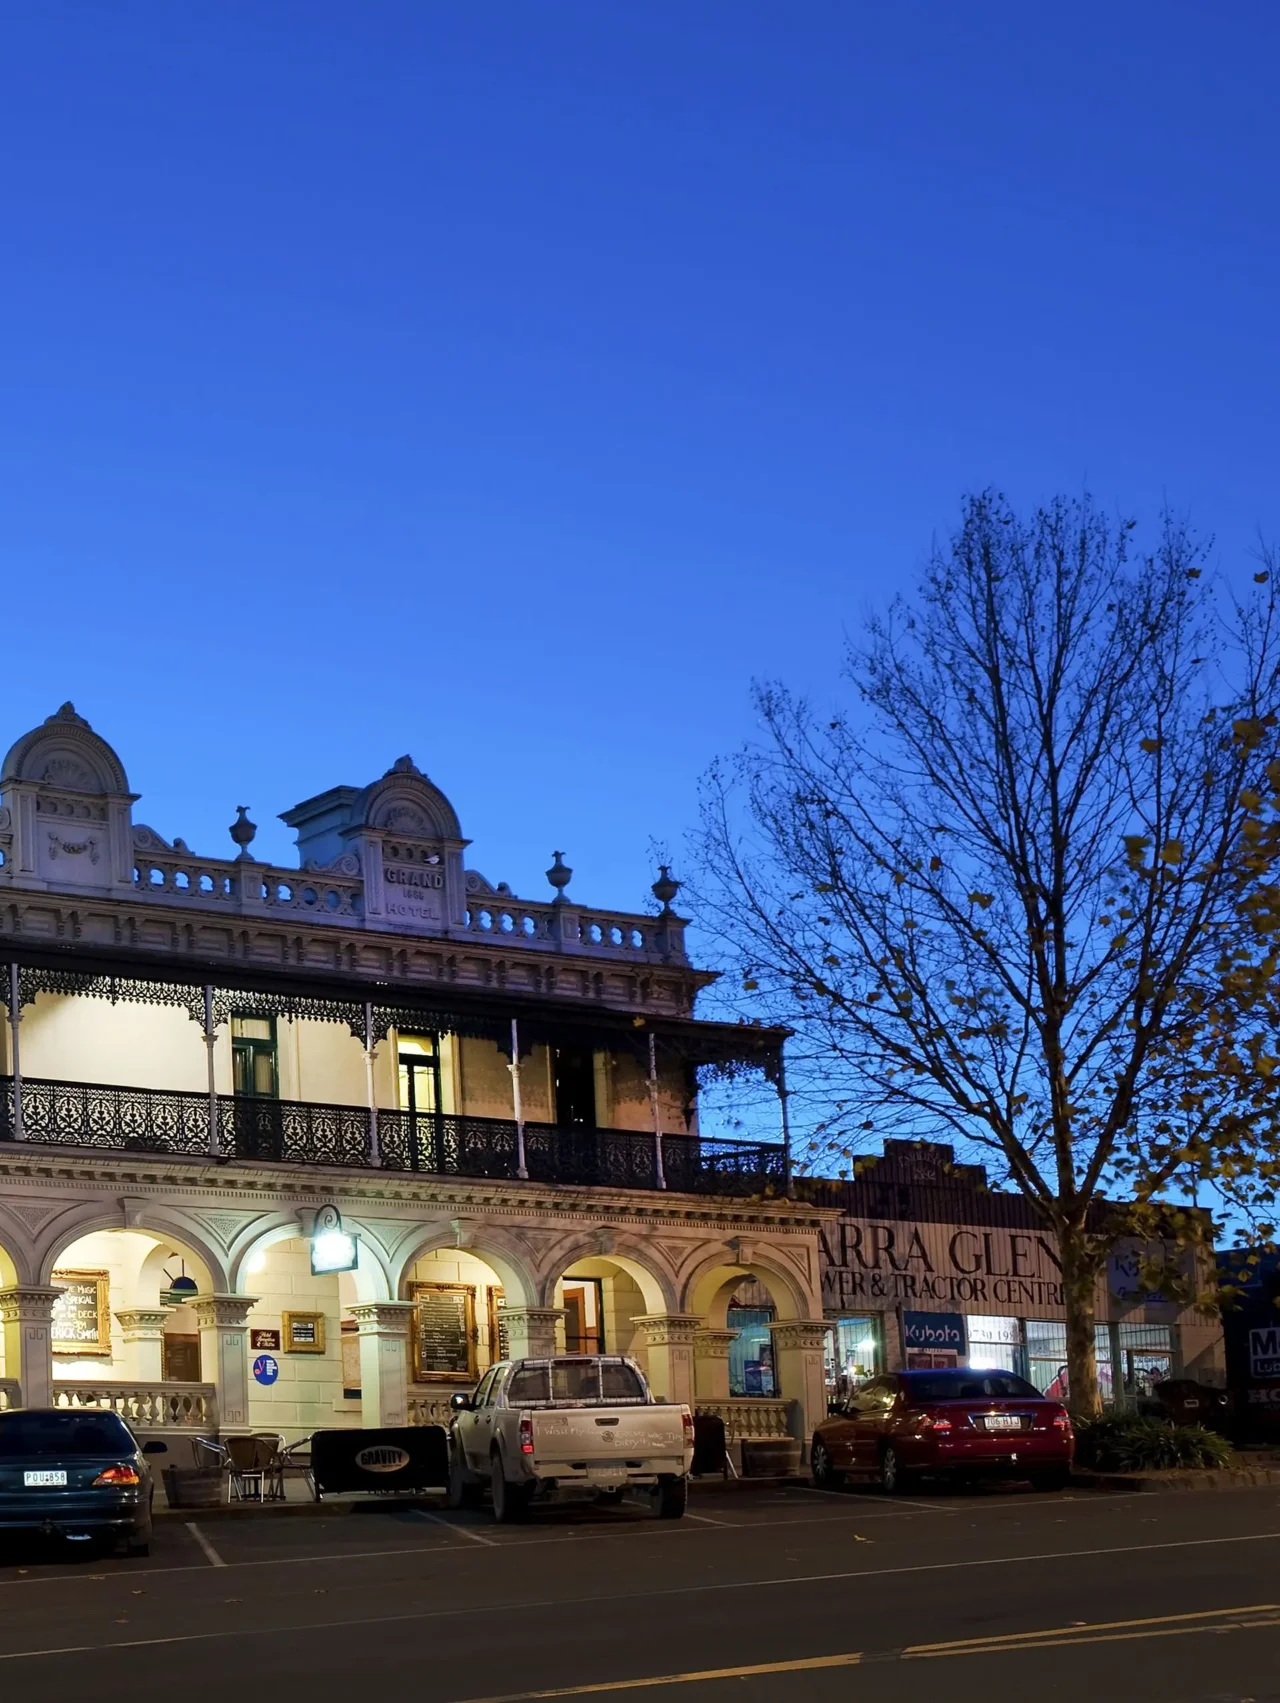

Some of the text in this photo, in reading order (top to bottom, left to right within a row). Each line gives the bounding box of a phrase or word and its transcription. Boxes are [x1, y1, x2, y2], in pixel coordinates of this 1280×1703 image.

[385, 868, 443, 889] GRAND
[385, 902, 440, 920] HOTEL
[870, 1272, 887, 1296] &
[890, 1272, 988, 1302] TRACTOR
[993, 1279, 1066, 1306] CENTRE
[77, 1310, 98, 1319] DECK
[905, 1324, 960, 1342] Kubota
[361, 1449, 402, 1465] GRAVITY
[26, 1472, 66, 1482] POU 858
